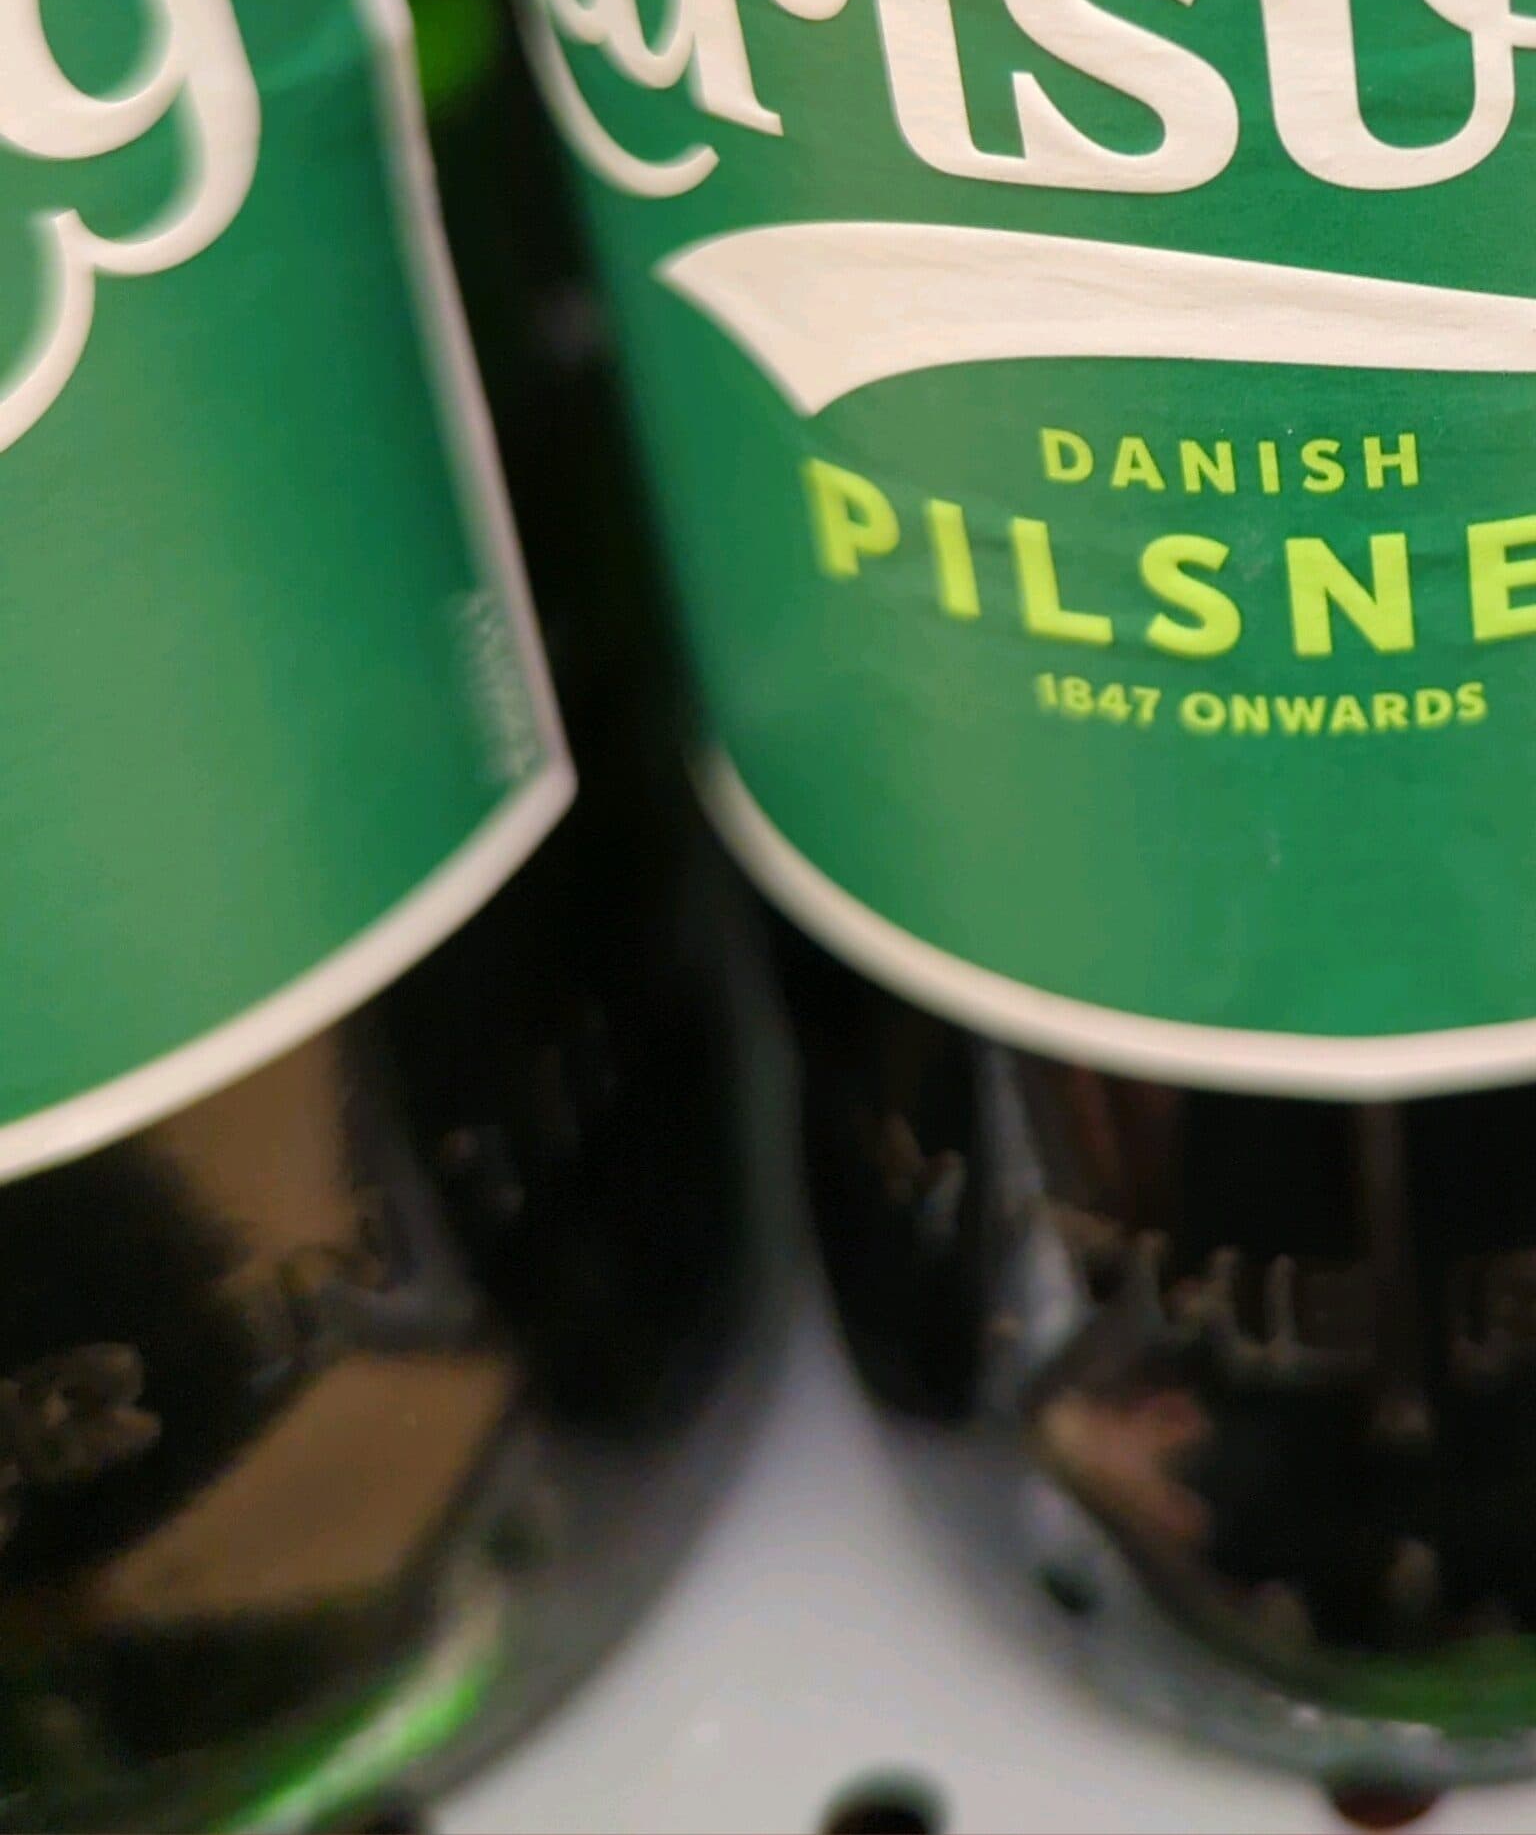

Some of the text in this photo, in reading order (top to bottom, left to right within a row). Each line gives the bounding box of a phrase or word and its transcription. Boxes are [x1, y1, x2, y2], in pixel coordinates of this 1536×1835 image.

[1040, 427, 1419, 494] DANISH
[1036, 672, 1487, 733] 1847 ONWARDS
